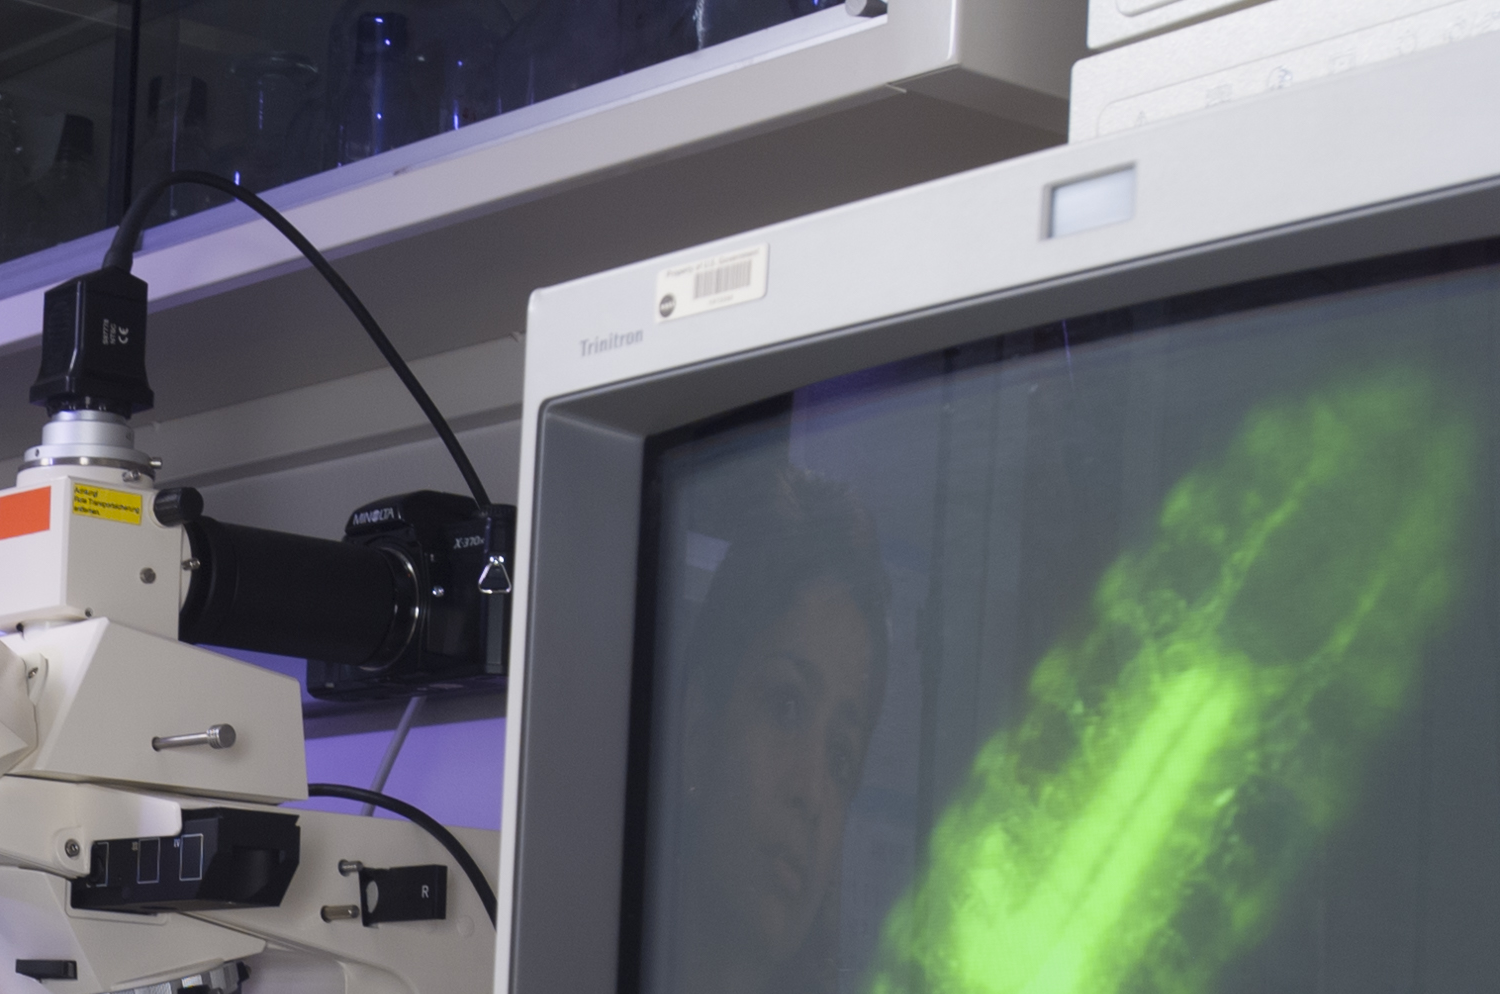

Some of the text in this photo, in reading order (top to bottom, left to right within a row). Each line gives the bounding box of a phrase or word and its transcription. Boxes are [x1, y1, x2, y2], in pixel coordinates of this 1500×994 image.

[579, 329, 644, 357] Trinitron
[352, 507, 395, 525] MINOLTA
[421, 885, 430, 898] R
